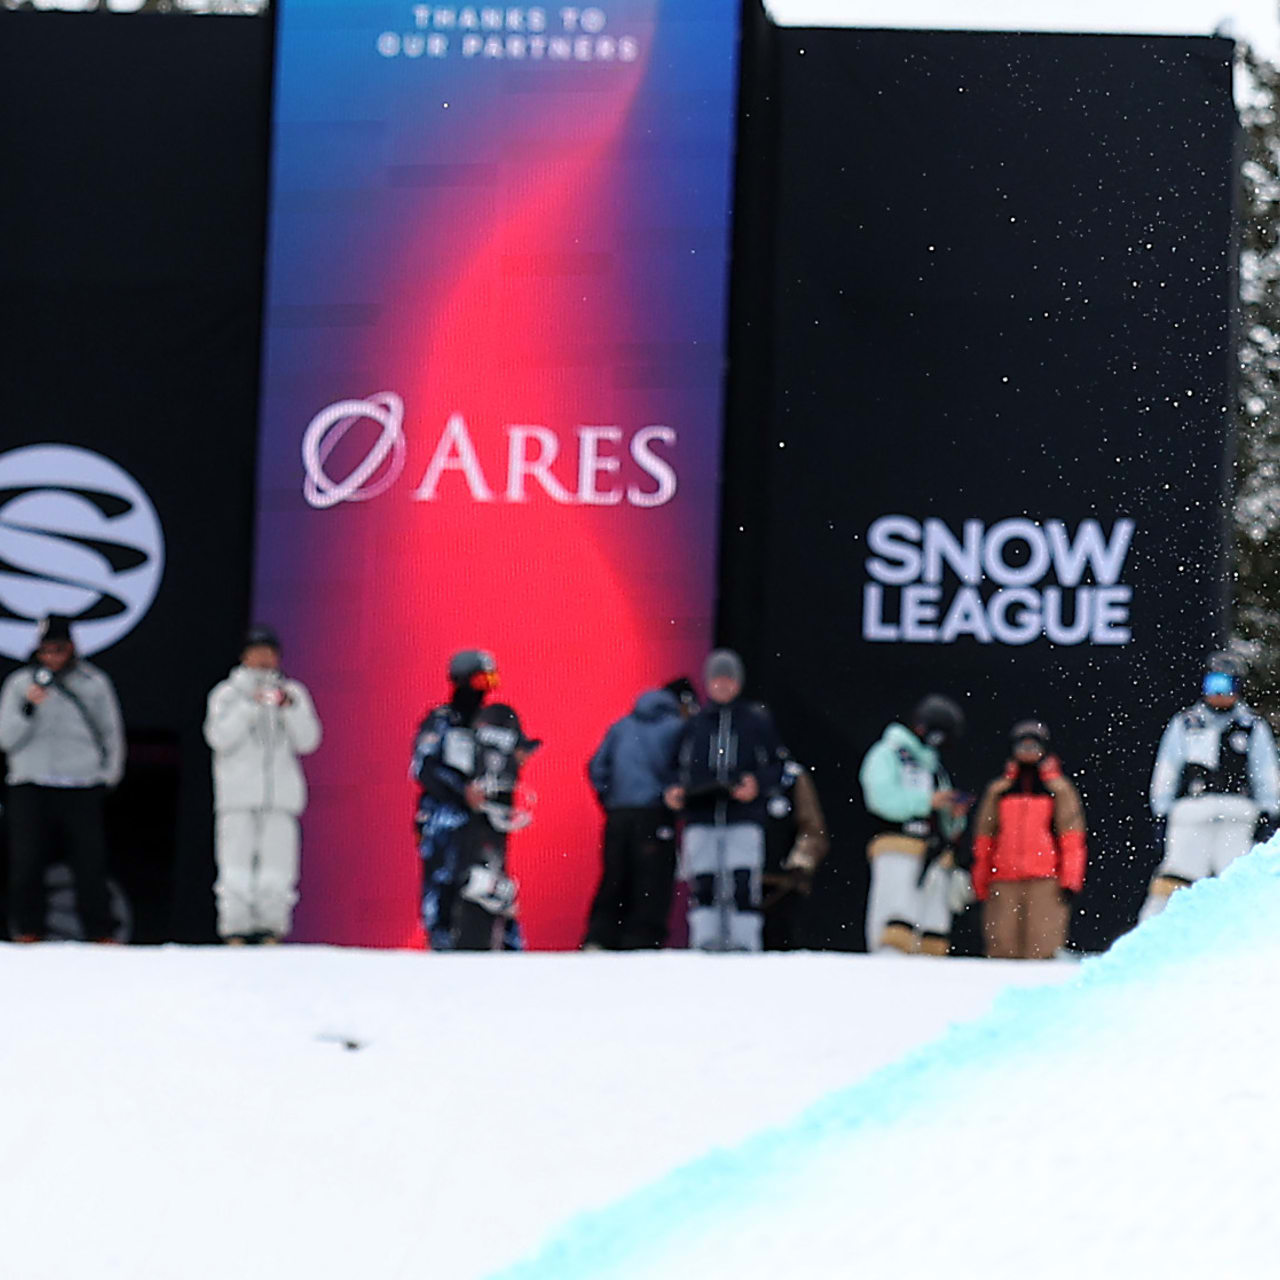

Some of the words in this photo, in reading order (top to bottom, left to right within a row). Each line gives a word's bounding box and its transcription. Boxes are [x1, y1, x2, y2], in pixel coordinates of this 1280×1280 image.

[377, 31, 448, 58] OUR
[462, 33, 638, 61] PARTNERS
[412, 4, 546, 31] THANKS
[560, 6, 606, 33] TO
[414, 414, 678, 508] ARES
[866, 514, 1135, 587] SNOW
[862, 584, 1132, 646] LEAGUE
